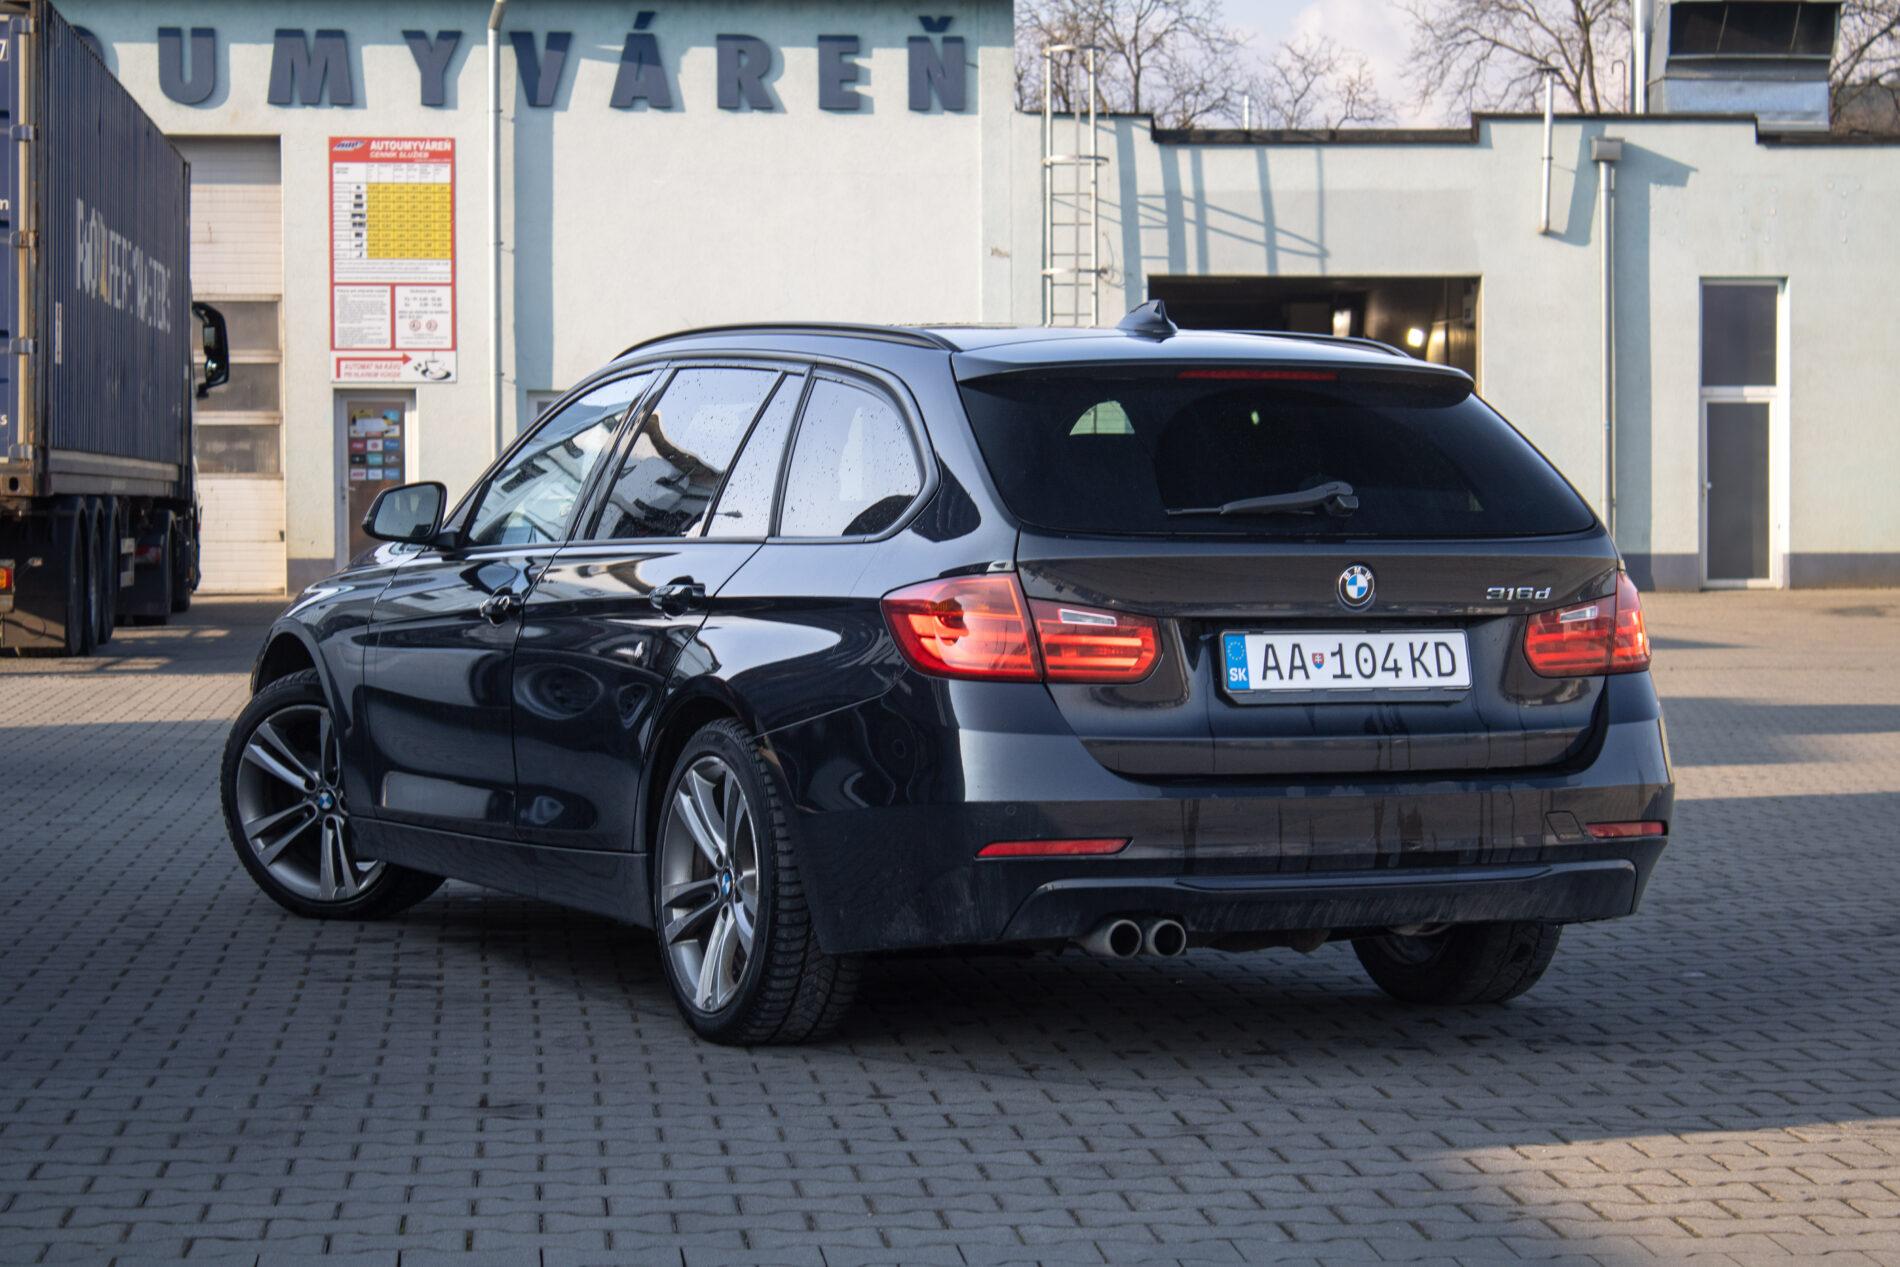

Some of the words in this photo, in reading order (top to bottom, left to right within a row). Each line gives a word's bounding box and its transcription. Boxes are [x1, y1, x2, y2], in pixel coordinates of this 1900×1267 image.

[72, 11, 968, 111] UMYVÁREŇ
[370, 139, 452, 151] AUTOUMYVÁREŇ
[1486, 587, 1552, 600] 316d
[1262, 642, 1310, 681] AA
[1330, 640, 1457, 679] 104KD
[1229, 667, 1248, 682] SK
